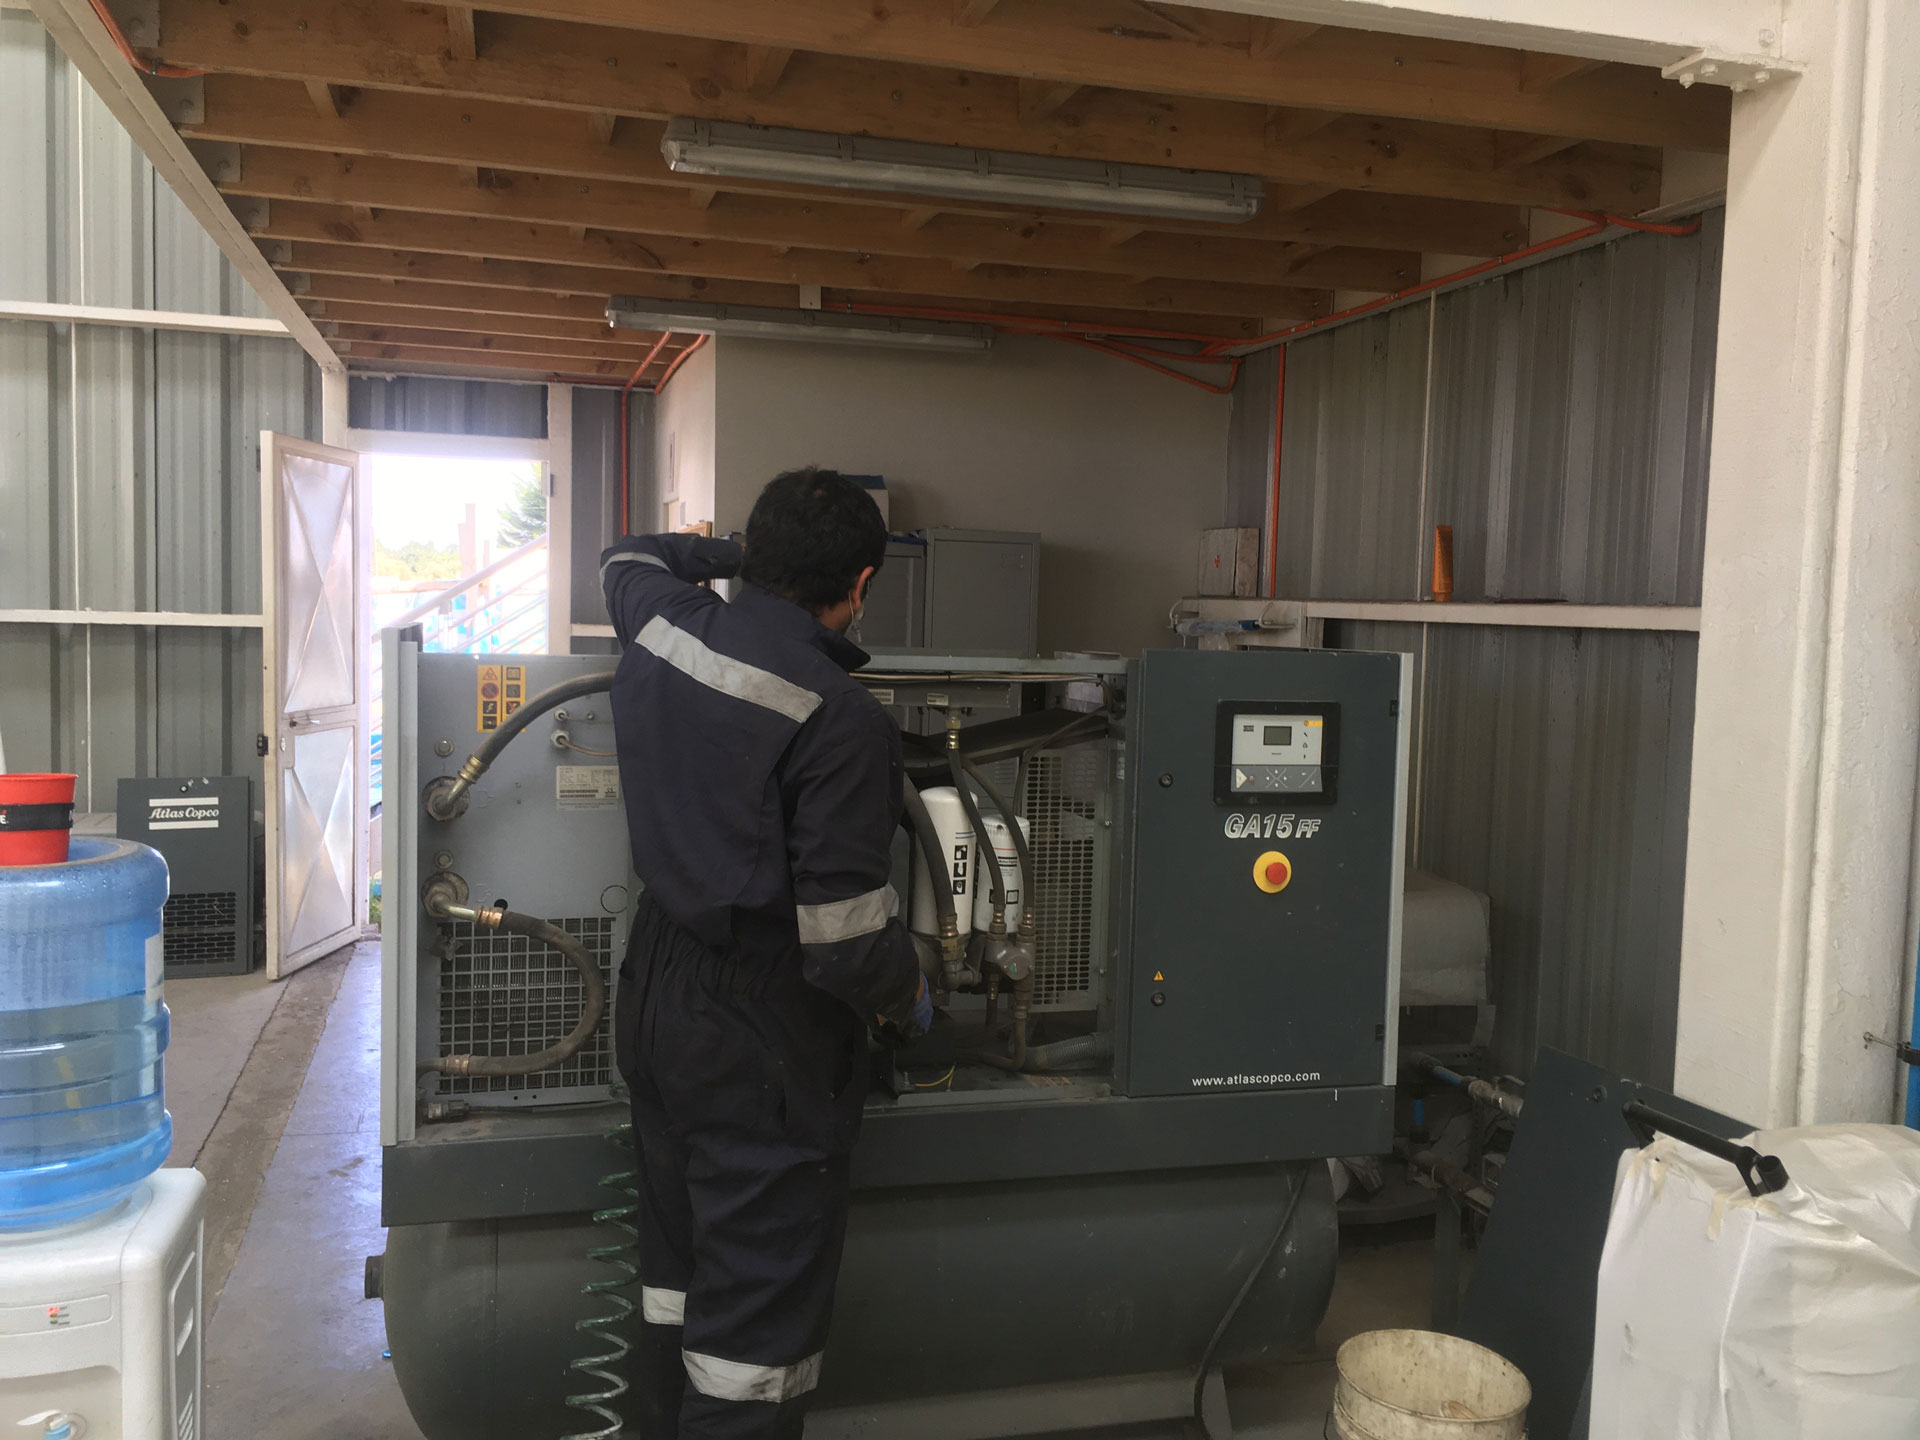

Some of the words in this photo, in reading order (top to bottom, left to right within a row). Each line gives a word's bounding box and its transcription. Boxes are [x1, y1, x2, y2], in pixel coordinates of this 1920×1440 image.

[149, 808, 184, 819] Atlas
[185, 807, 219, 819] Copco
[1192, 1072, 1320, 1086] www.atlascopco.com
